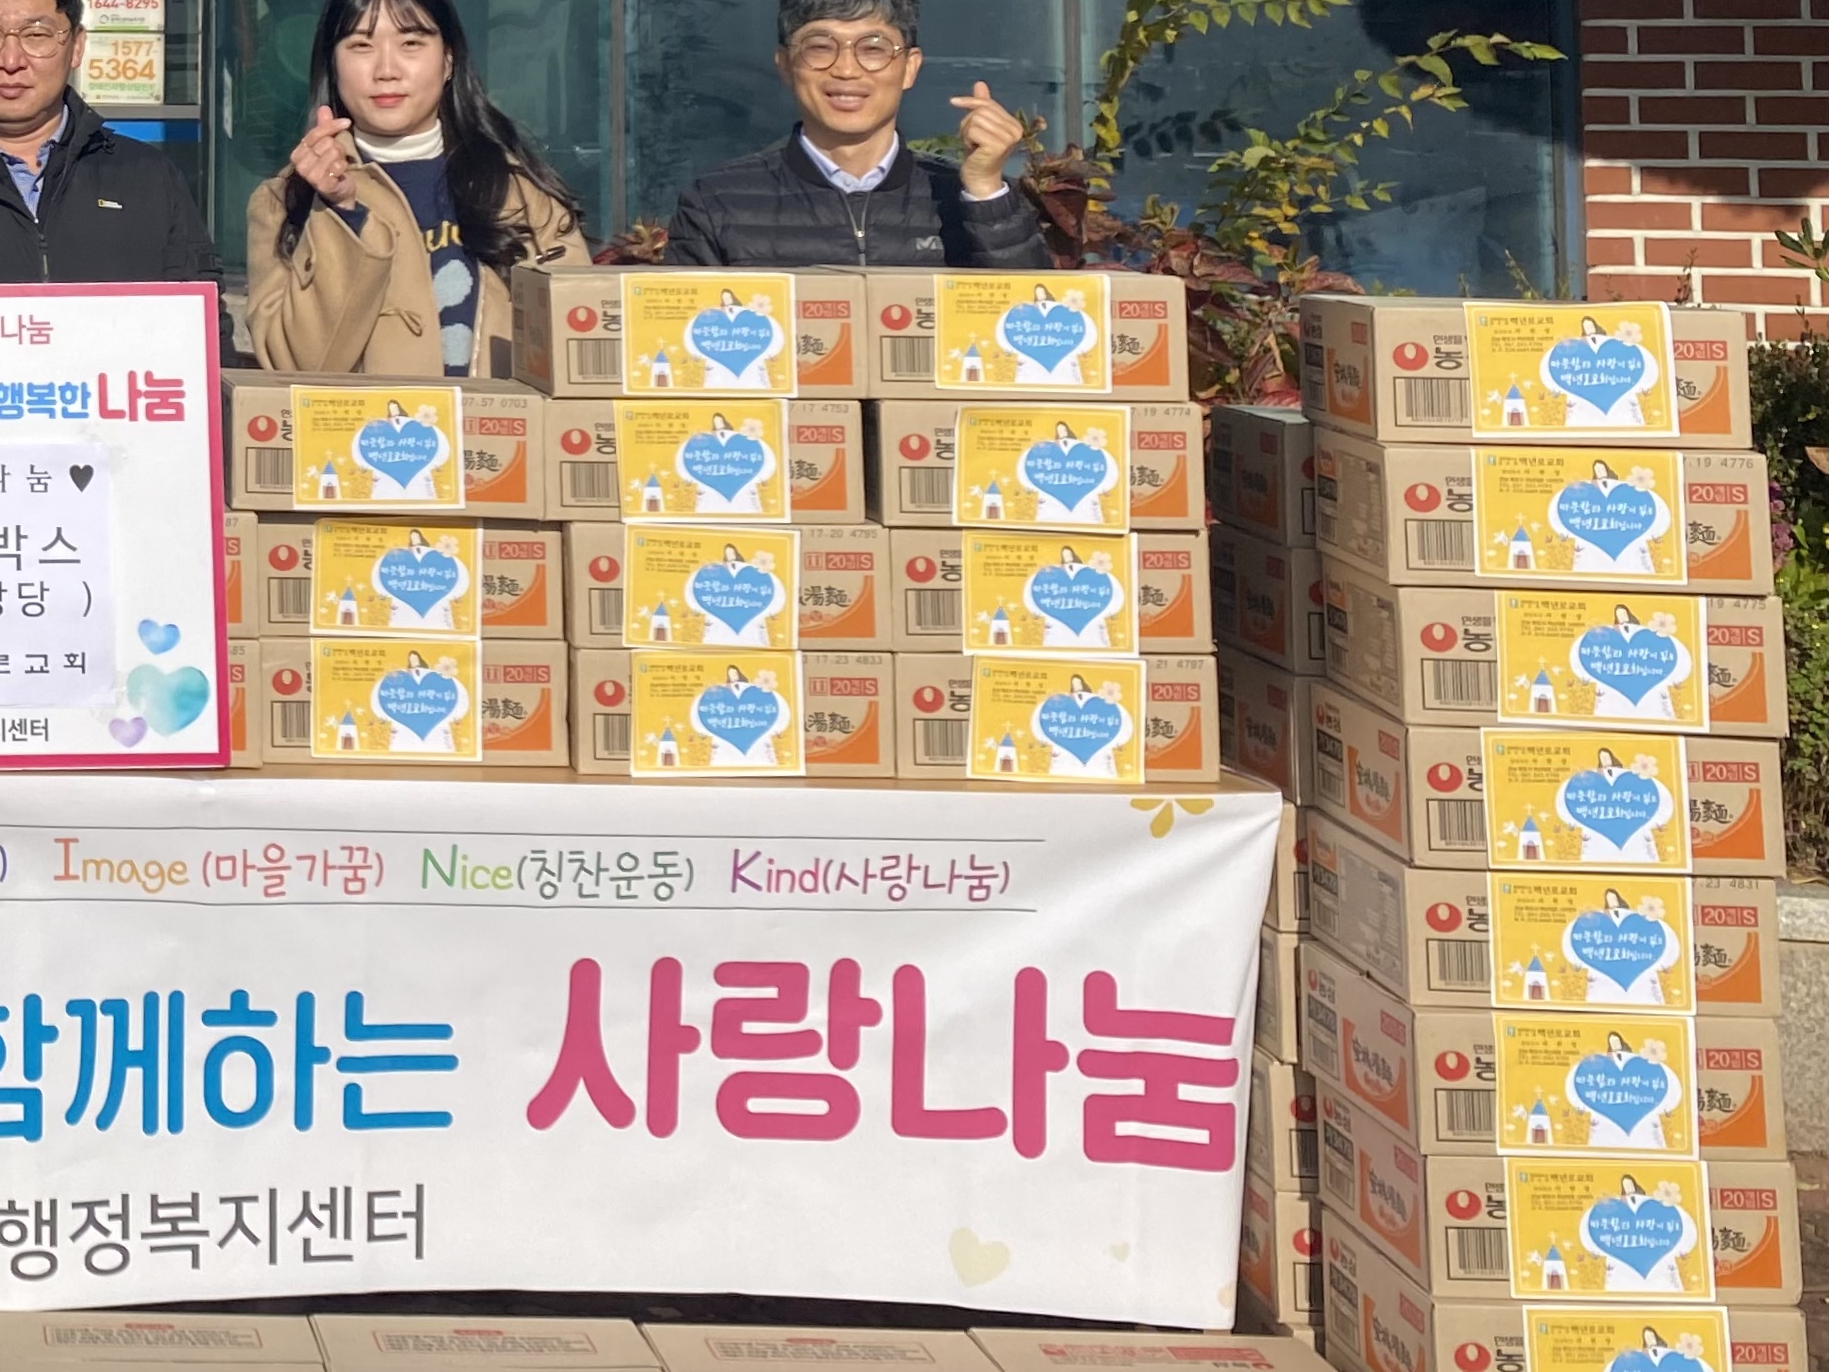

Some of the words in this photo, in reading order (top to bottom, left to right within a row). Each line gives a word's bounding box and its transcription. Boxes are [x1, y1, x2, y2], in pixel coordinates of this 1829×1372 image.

[89, 58, 156, 80] 5364
[97, 370, 186, 422] 나눔
[53, 837, 190, 894] Image
[201, 842, 384, 898] (마을가꿈)
[421, 844, 694, 900] Nice(칭찬운동)
[731, 848, 1011, 903] Kind(사랑나눔)
[525, 956, 1239, 1173] 사랑나눔
